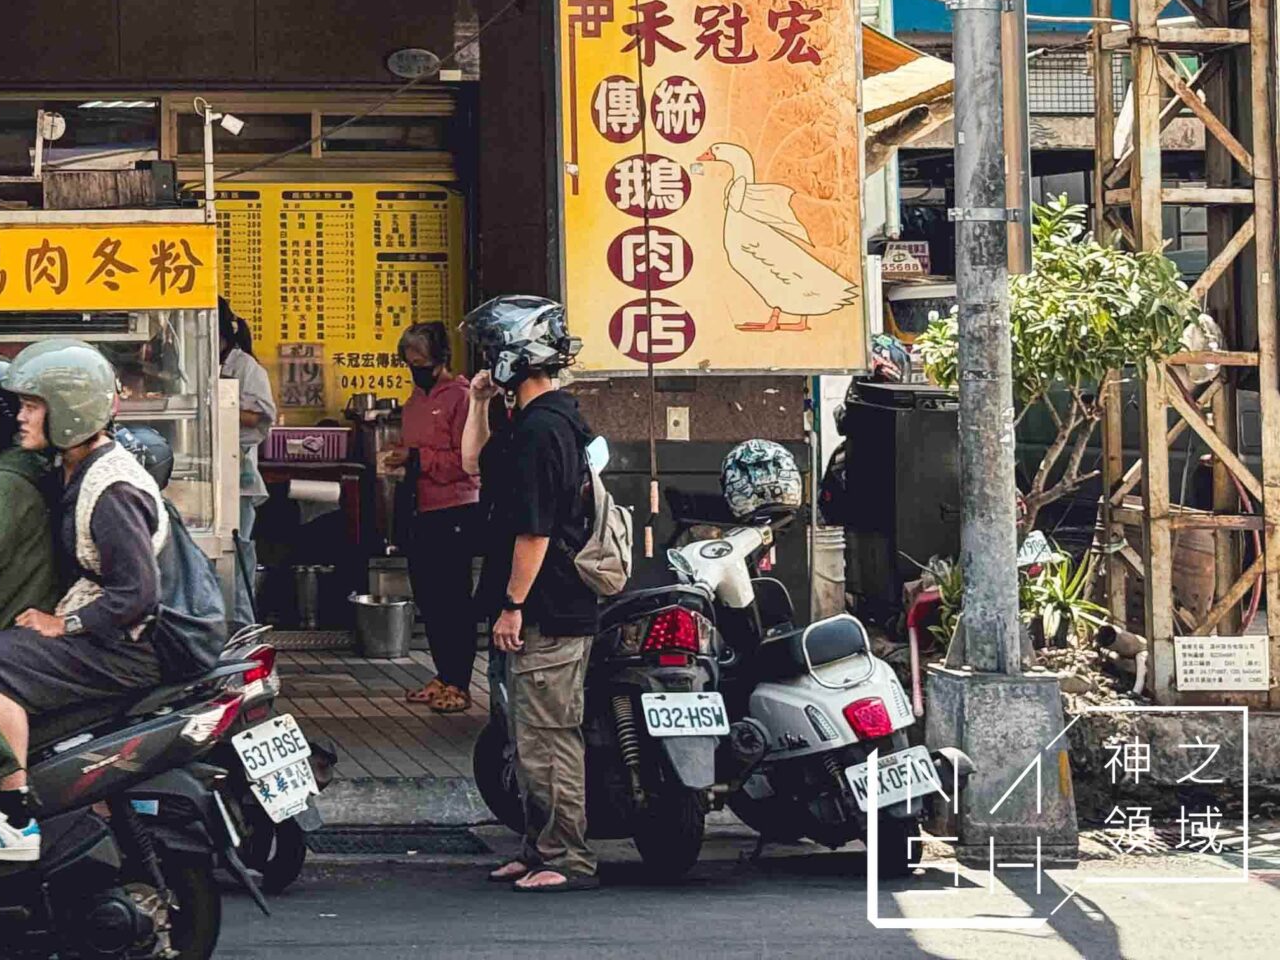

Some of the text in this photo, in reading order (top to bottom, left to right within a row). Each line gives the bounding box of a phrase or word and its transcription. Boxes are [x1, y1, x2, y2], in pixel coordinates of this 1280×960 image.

[621, 0, 823, 67] 禾冠宏
[594, 80, 702, 136] 傳統
